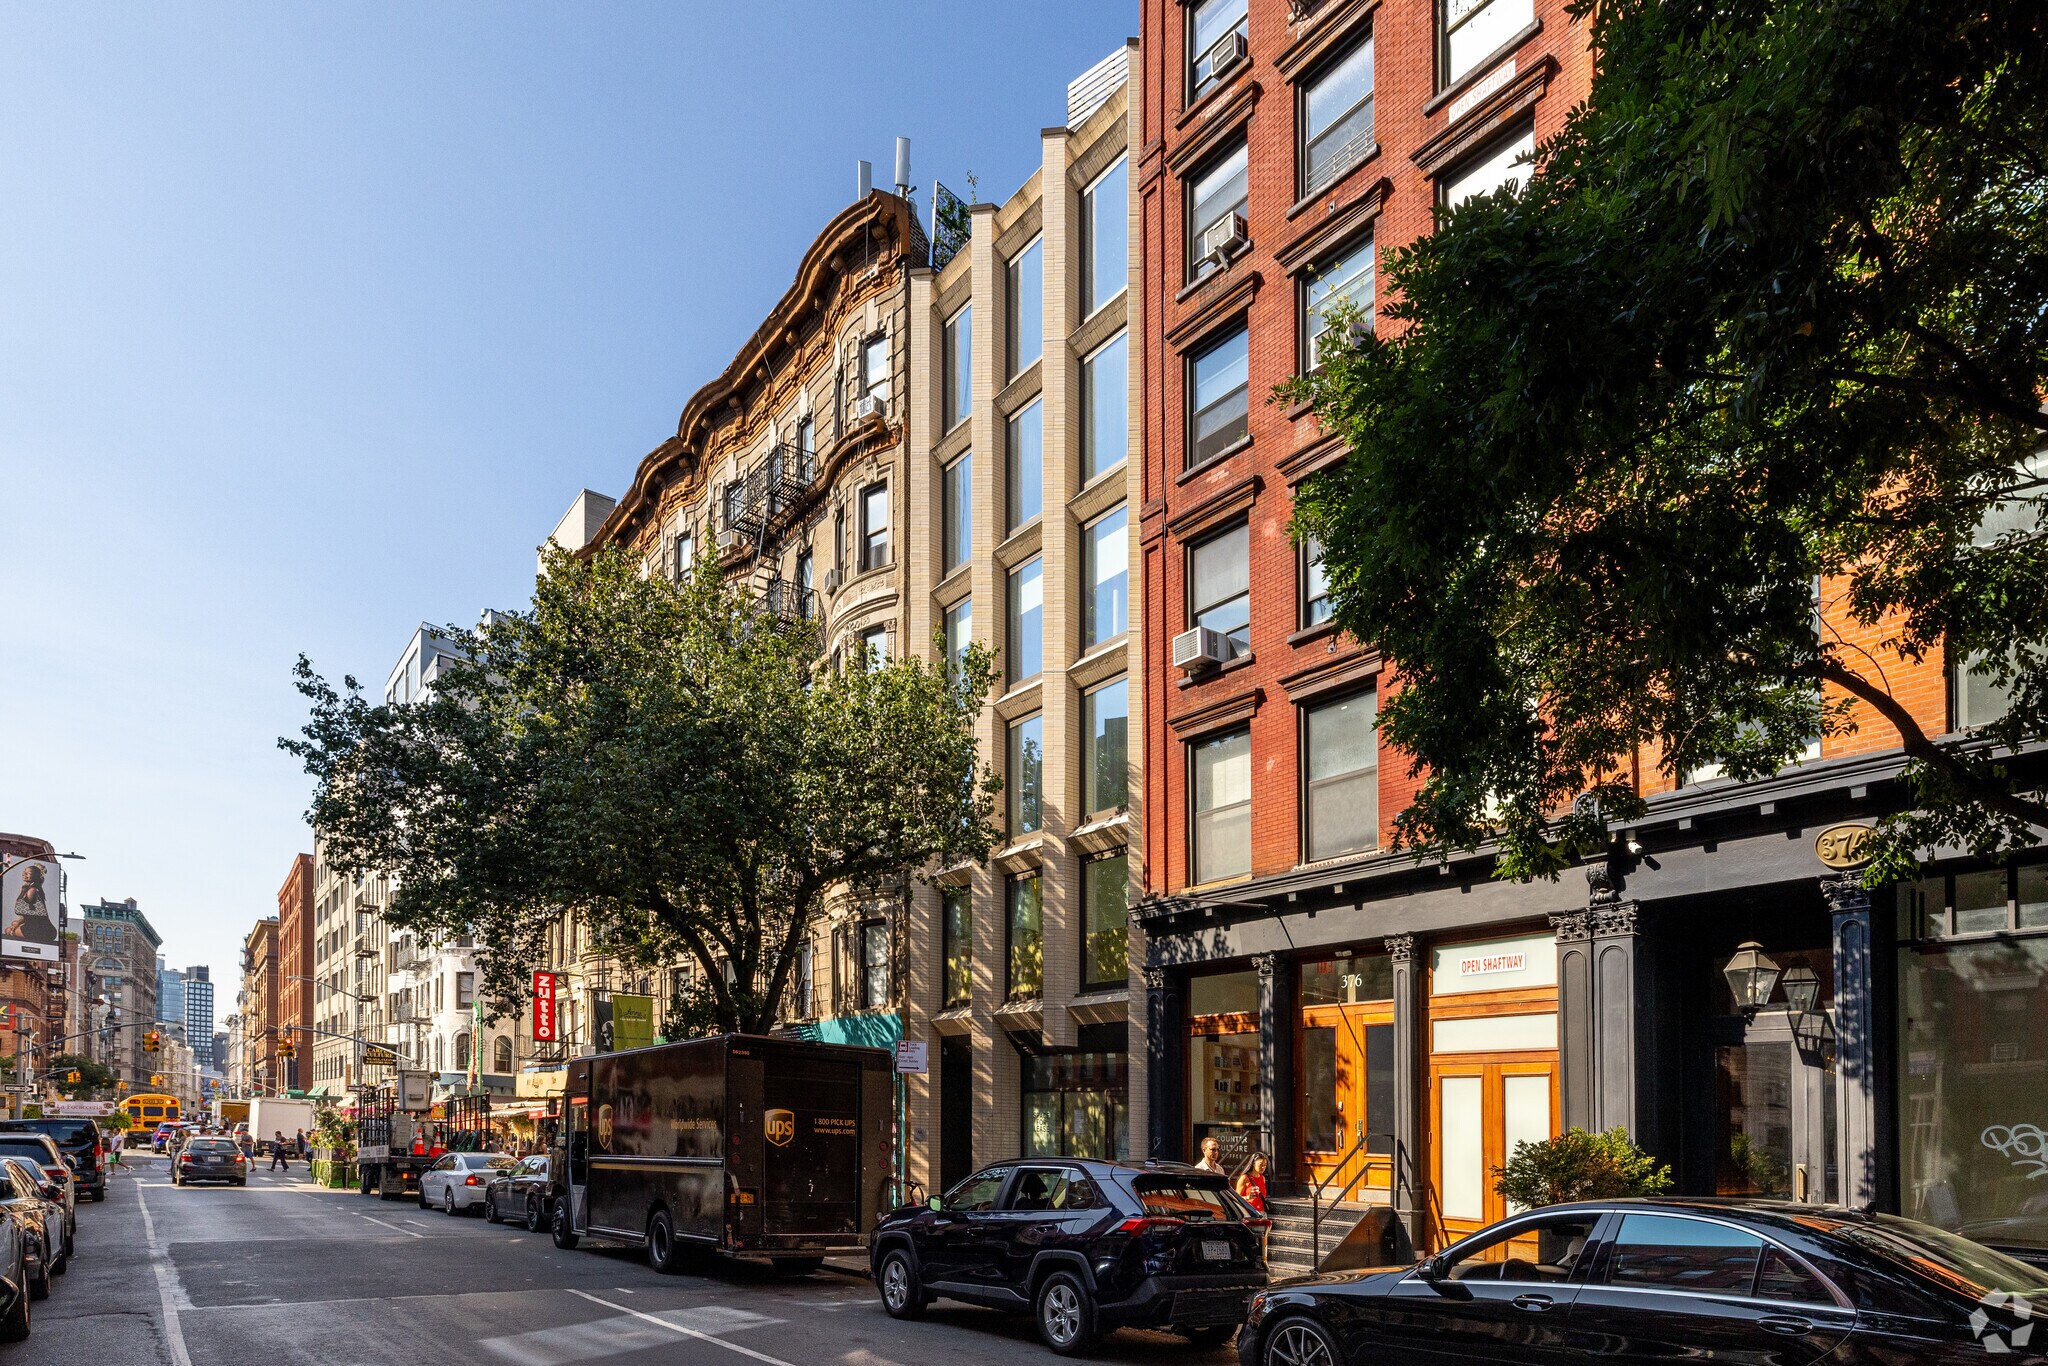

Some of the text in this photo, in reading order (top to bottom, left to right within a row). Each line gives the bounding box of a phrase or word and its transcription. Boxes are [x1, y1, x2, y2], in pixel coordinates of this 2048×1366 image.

[1461, 955, 1523, 973] OPEN SHAFTWAY
[1341, 973, 1362, 989] 376
[696, 1118, 717, 1130] Services
[844, 1119, 856, 1127] UPS
[767, 1120, 792, 1141] ups
[813, 1127, 856, 1136] www.ups.com
[1218, 1144, 1248, 1153] ULTURE
